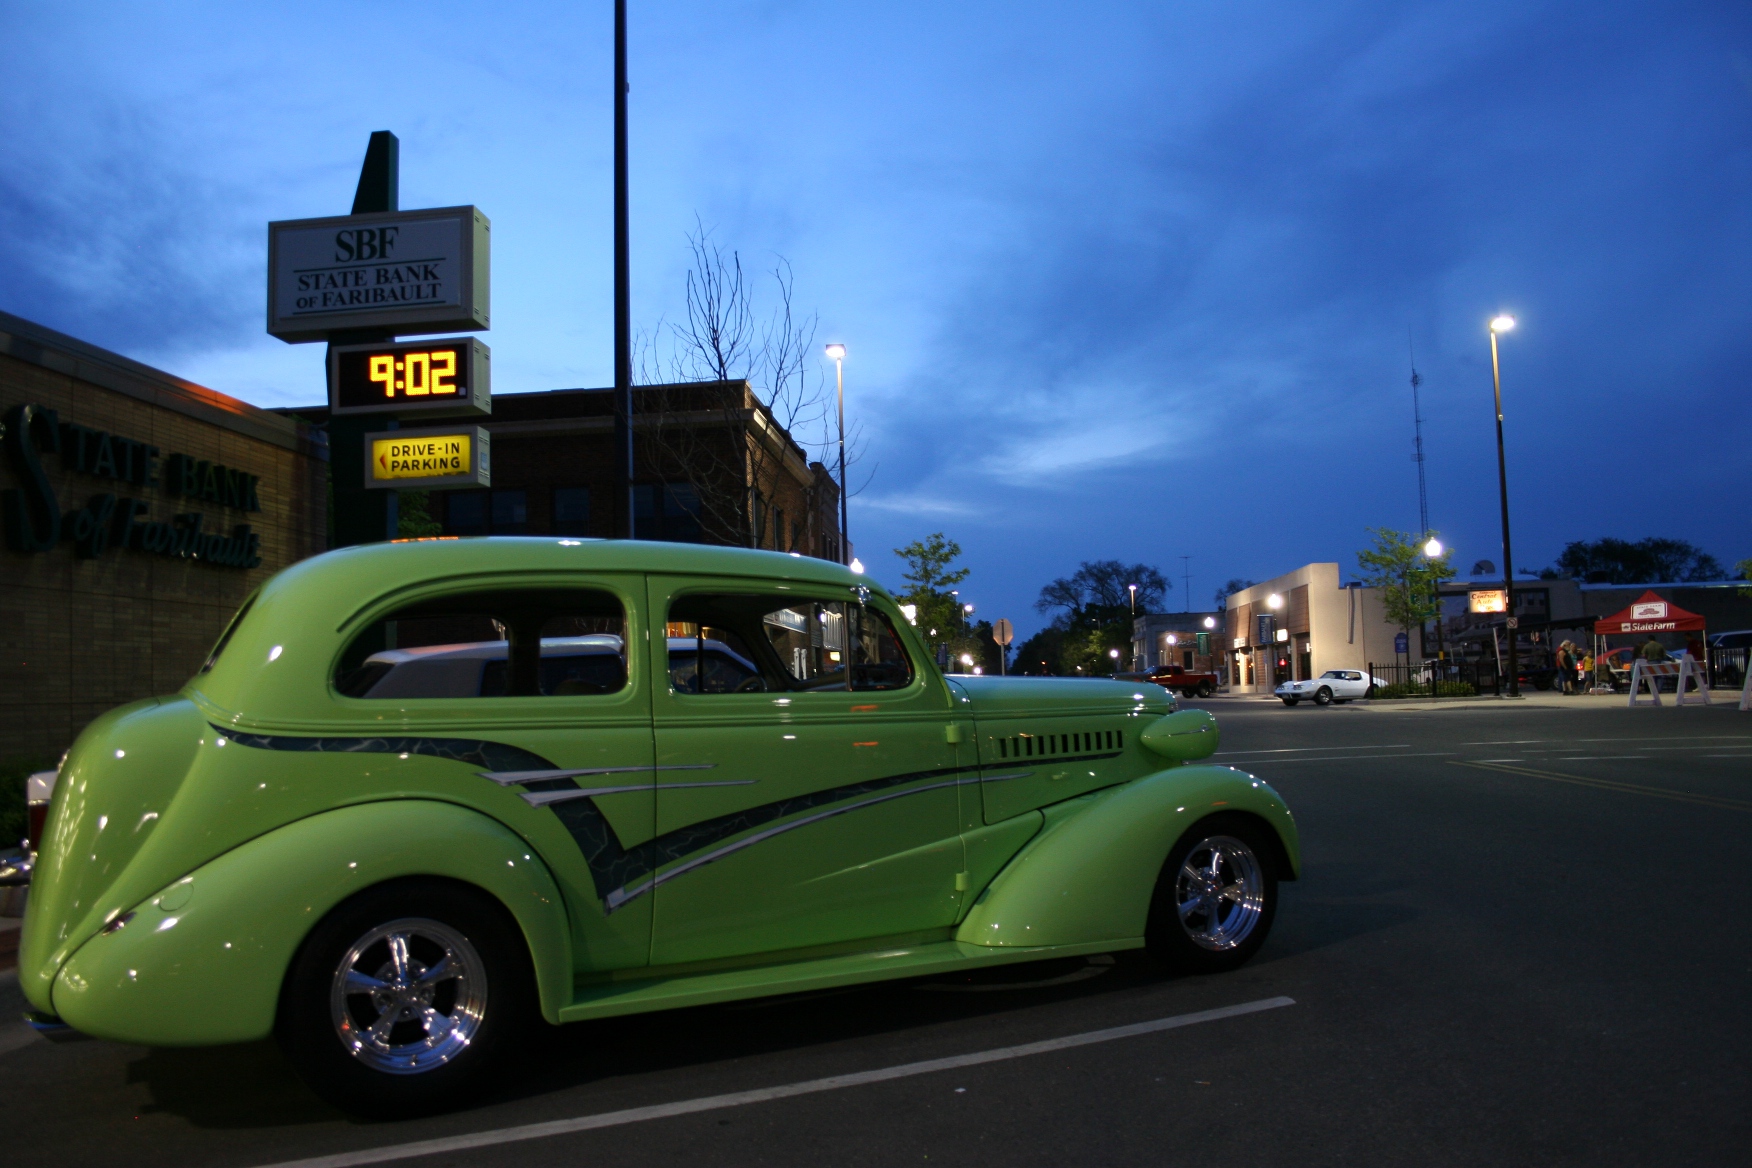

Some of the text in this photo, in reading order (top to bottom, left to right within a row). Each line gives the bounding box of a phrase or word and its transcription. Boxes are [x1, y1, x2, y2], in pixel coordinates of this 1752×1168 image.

[335, 226, 399, 263] SBF
[297, 264, 440, 292] STATE BANK
[296, 282, 442, 309] OF FARIBAULT
[369, 350, 457, 397] 9:02
[390, 441, 461, 458] DRIVE-IN
[390, 456, 461, 472] PARKING
[179, 453, 261, 512] BANK
[74, 493, 262, 568] of Faribault
